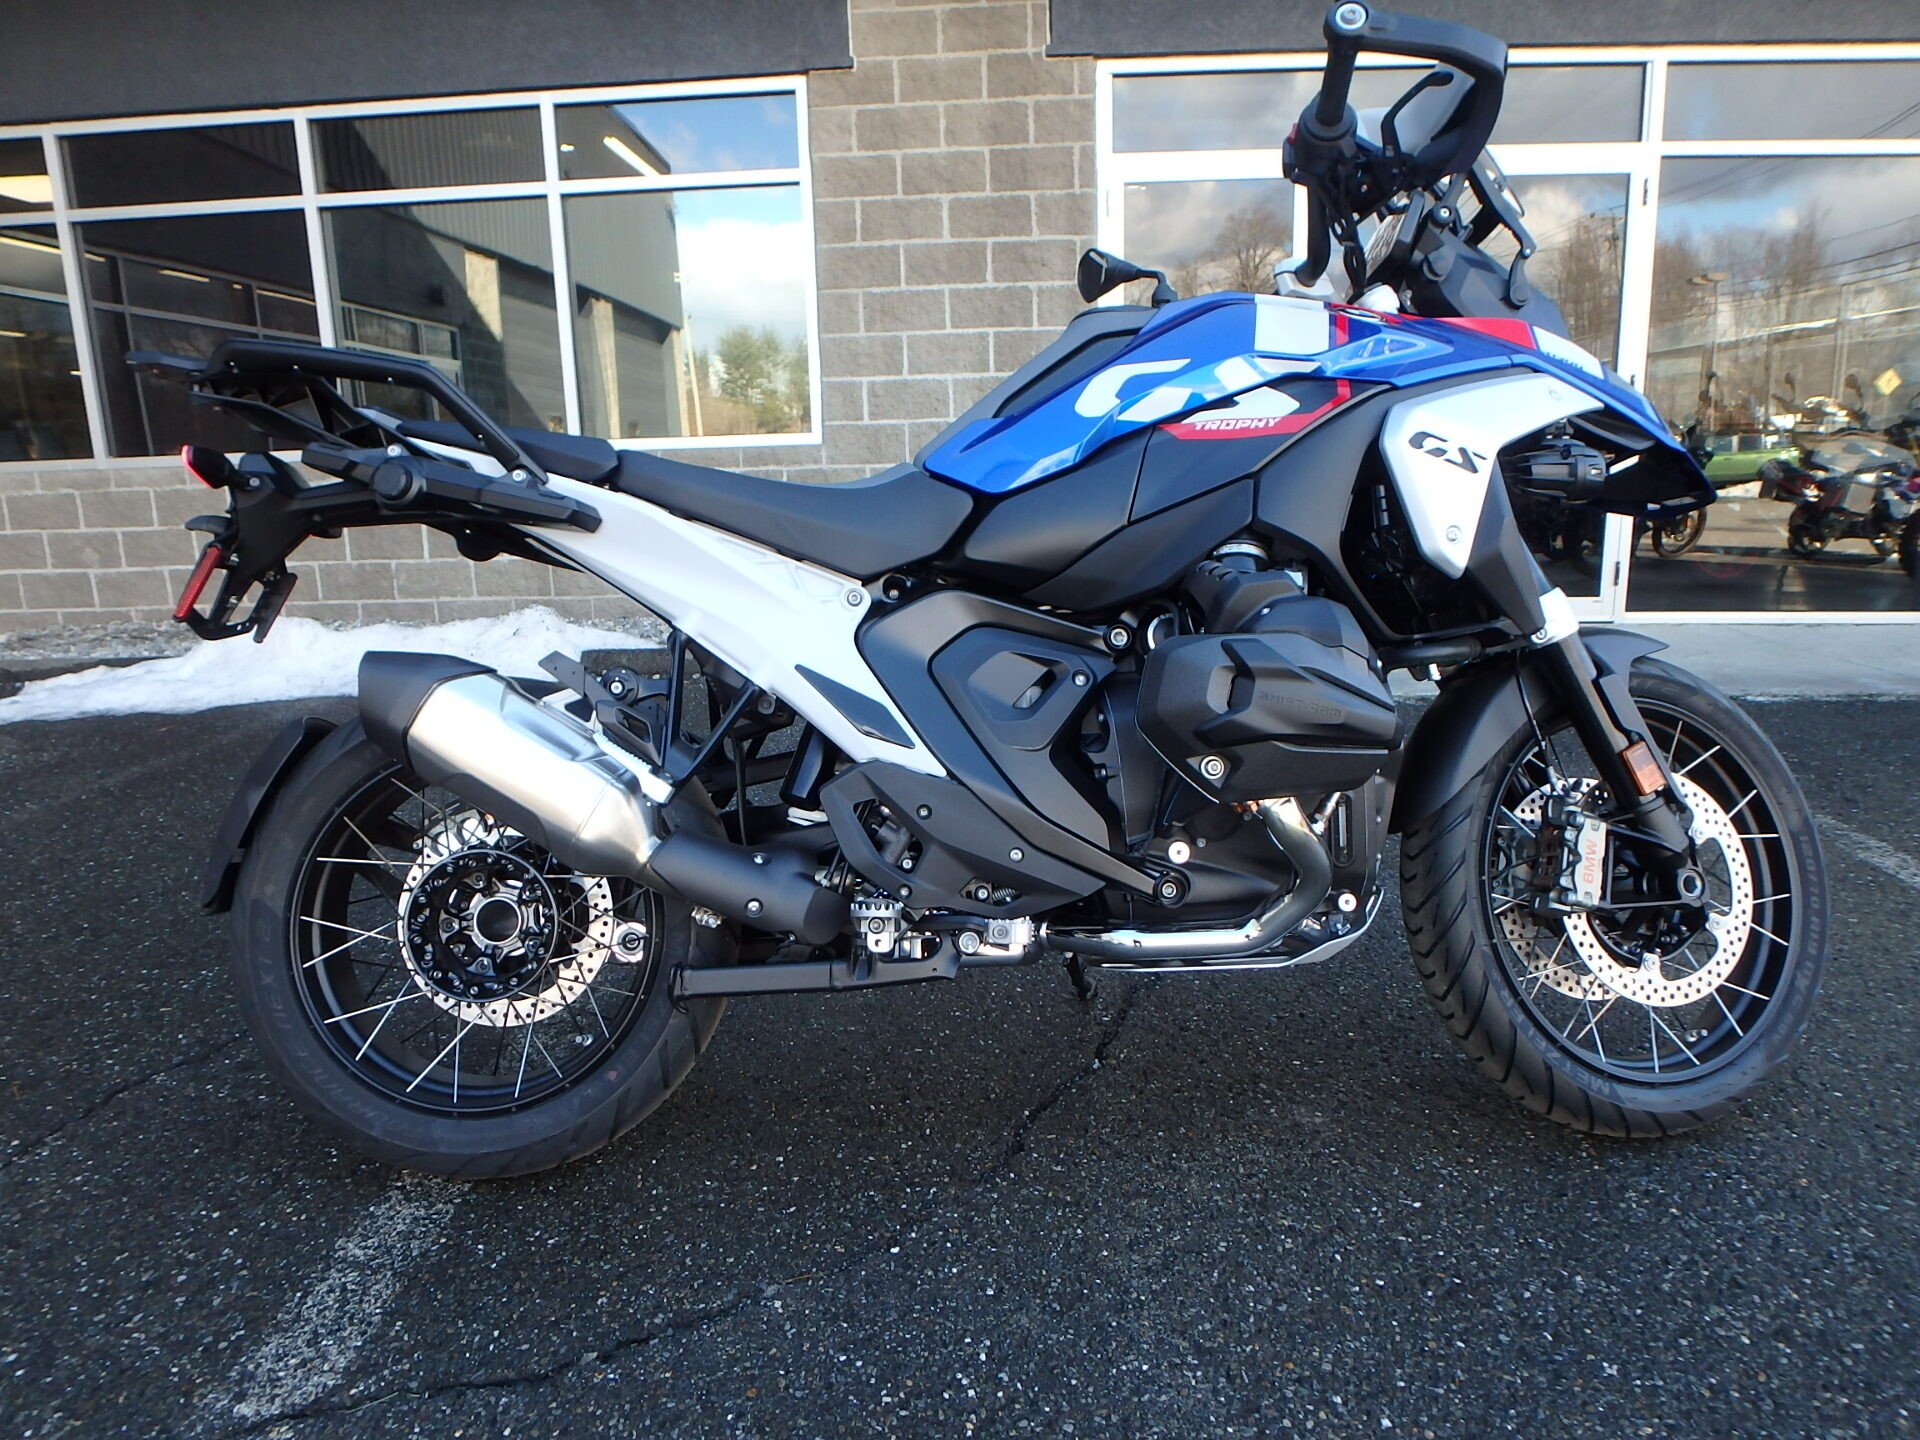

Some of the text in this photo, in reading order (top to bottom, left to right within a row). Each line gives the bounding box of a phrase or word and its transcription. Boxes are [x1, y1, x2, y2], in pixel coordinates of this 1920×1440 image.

[1194, 417, 1282, 431] TROPHY
[1408, 431, 1488, 474] GS
[1583, 840, 1598, 884] BMW
[1495, 988, 1610, 1095] METZELER
